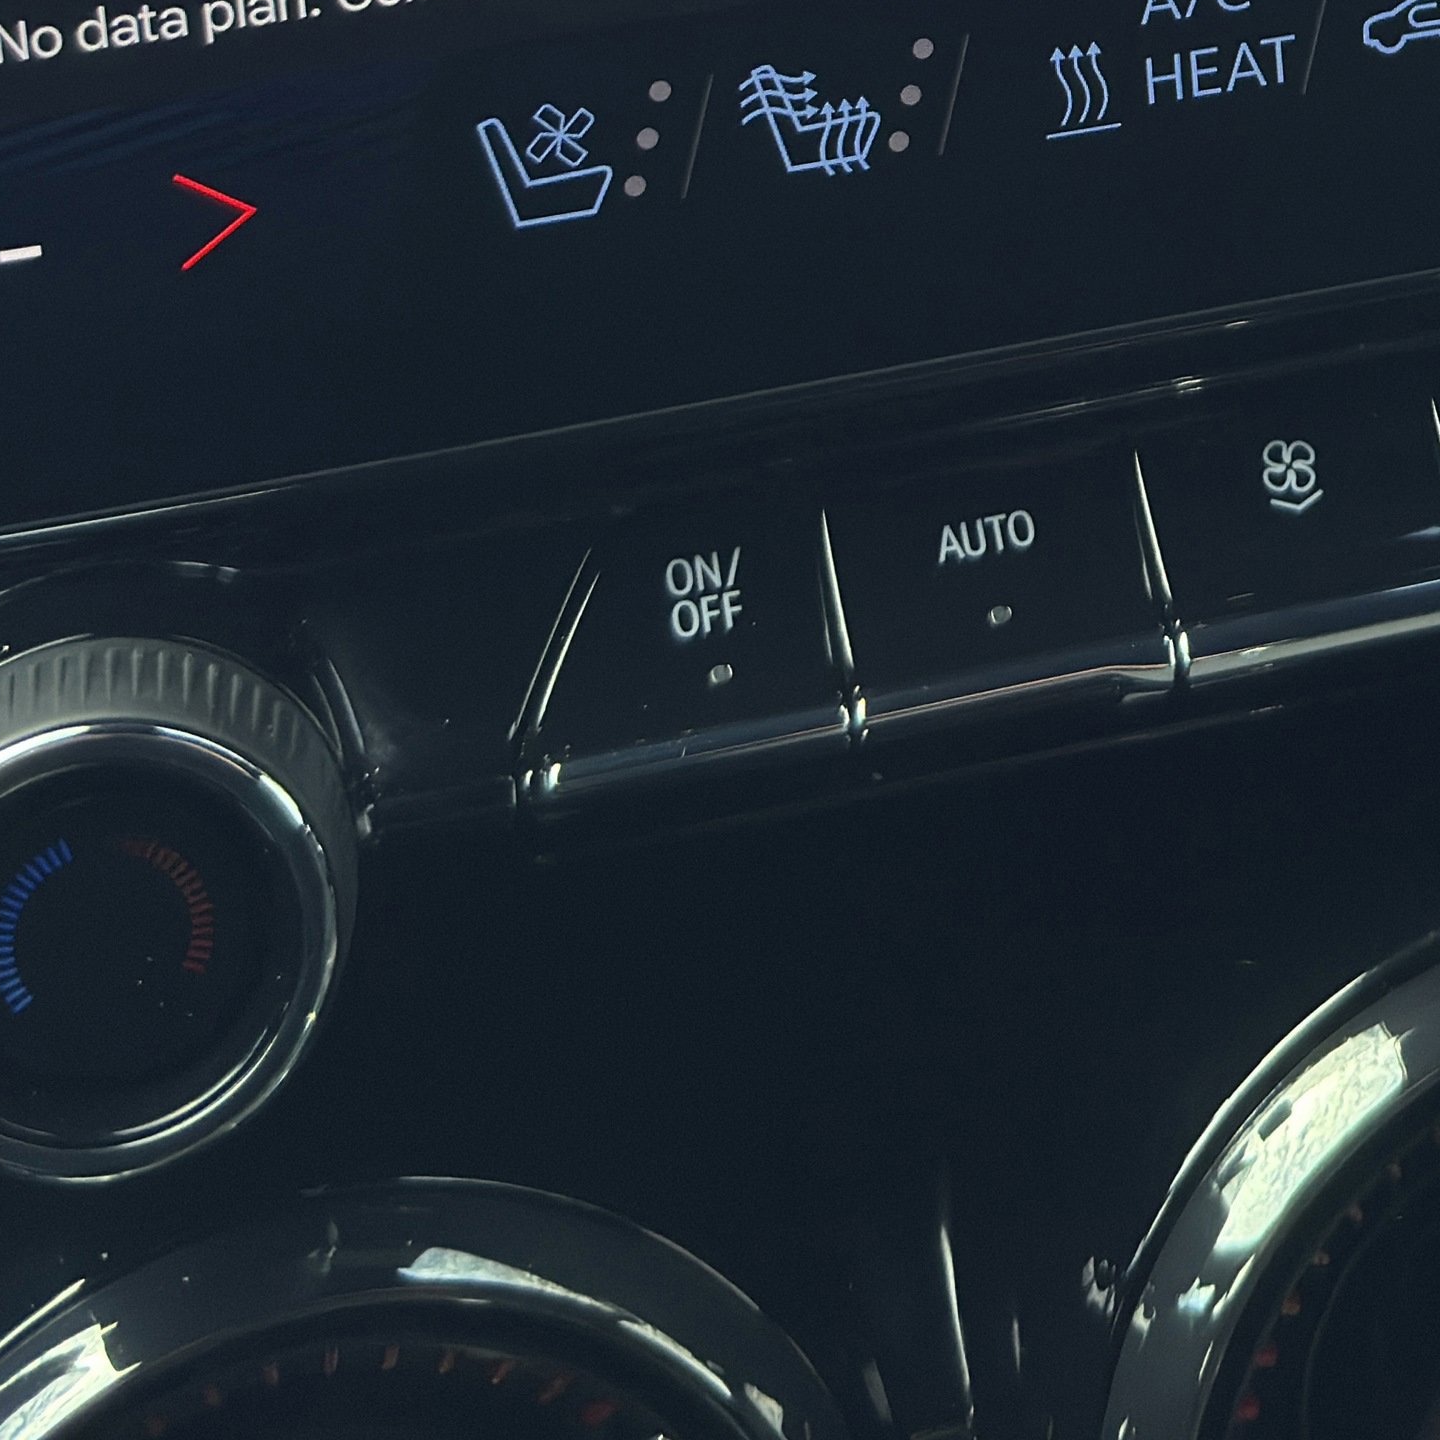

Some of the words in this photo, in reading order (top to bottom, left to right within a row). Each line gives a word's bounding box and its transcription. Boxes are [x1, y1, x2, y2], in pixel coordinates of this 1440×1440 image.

[76, 4, 189, 54] data
[1145, 33, 1297, 103] HEAT
[938, 510, 1036, 564] AUTO
[665, 546, 741, 596] ON/
[670, 590, 744, 639] OFF
